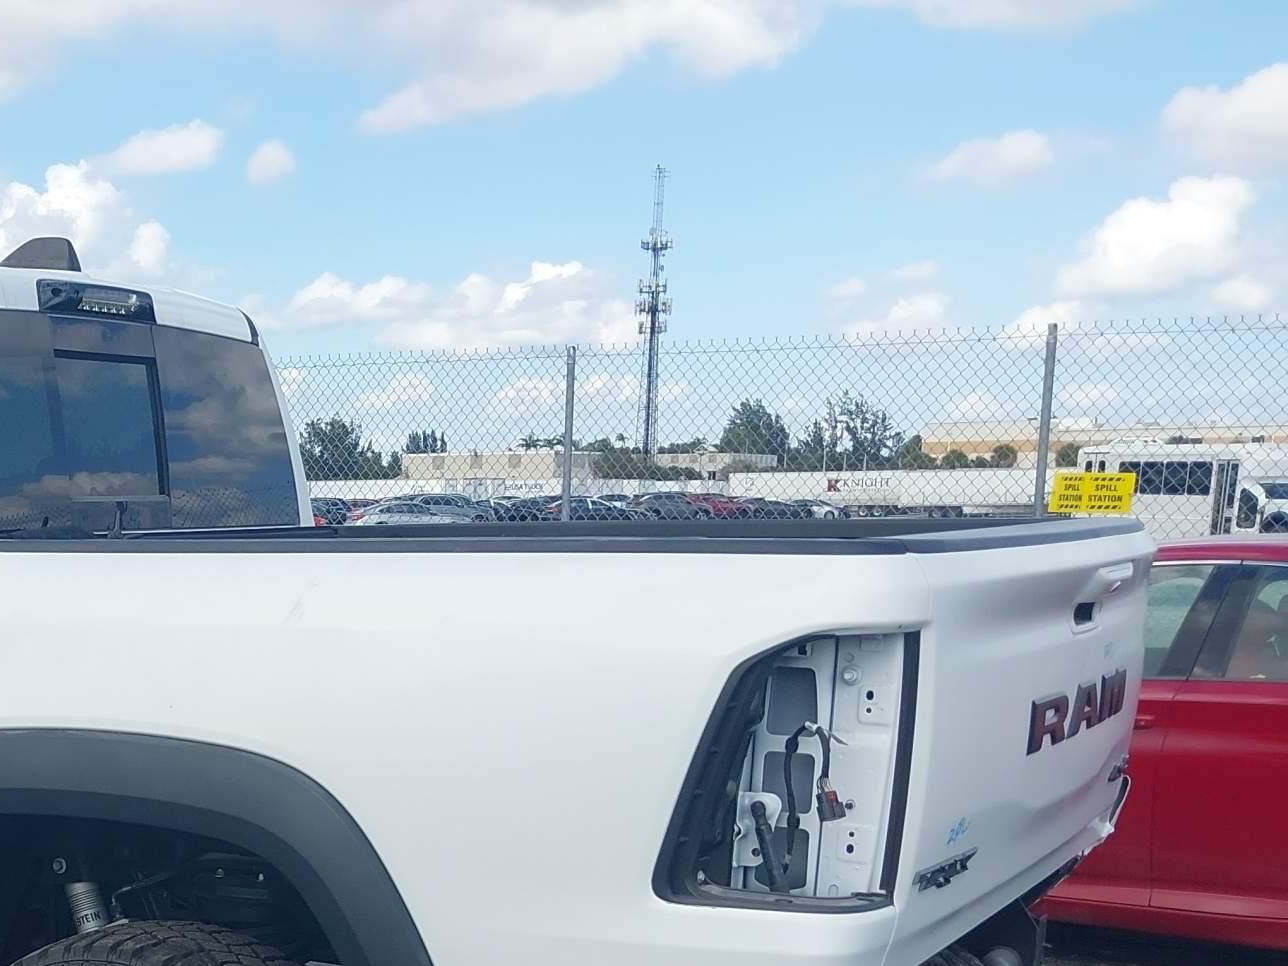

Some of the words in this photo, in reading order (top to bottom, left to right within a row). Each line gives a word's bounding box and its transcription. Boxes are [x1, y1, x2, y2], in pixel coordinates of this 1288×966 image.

[842, 477, 891, 488] KNIGHT
[1064, 483, 1080, 492] SPILL
[1094, 484, 1119, 492] SPILL
[1058, 493, 1082, 502] STATION
[1087, 494, 1123, 503] STATION
[1026, 667, 1127, 757] RAM
